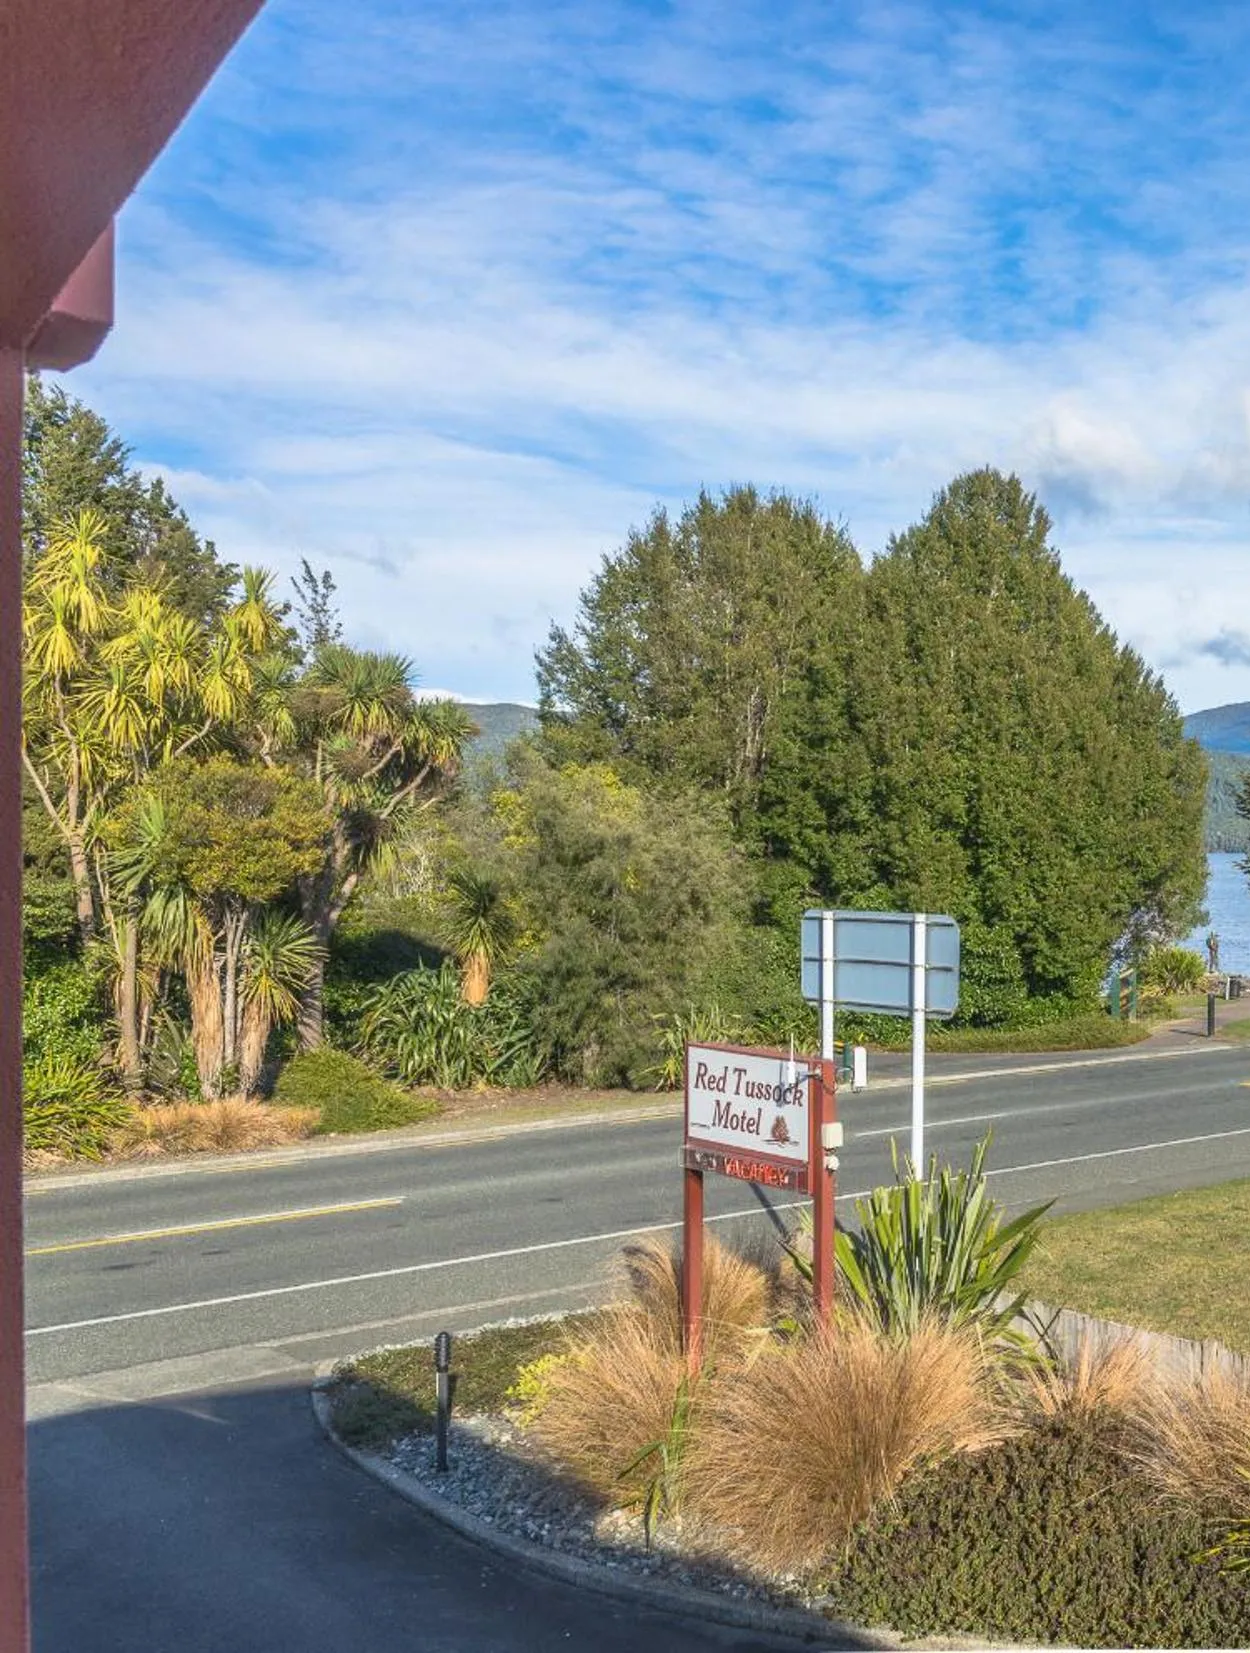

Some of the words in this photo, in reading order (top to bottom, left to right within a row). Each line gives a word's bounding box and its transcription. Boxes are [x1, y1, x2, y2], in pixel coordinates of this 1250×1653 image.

[694, 1062, 729, 1094] Red
[732, 1066, 804, 1107] Tussock
[712, 1099, 762, 1136] Motel
[724, 1157, 789, 1187] VACANCY
